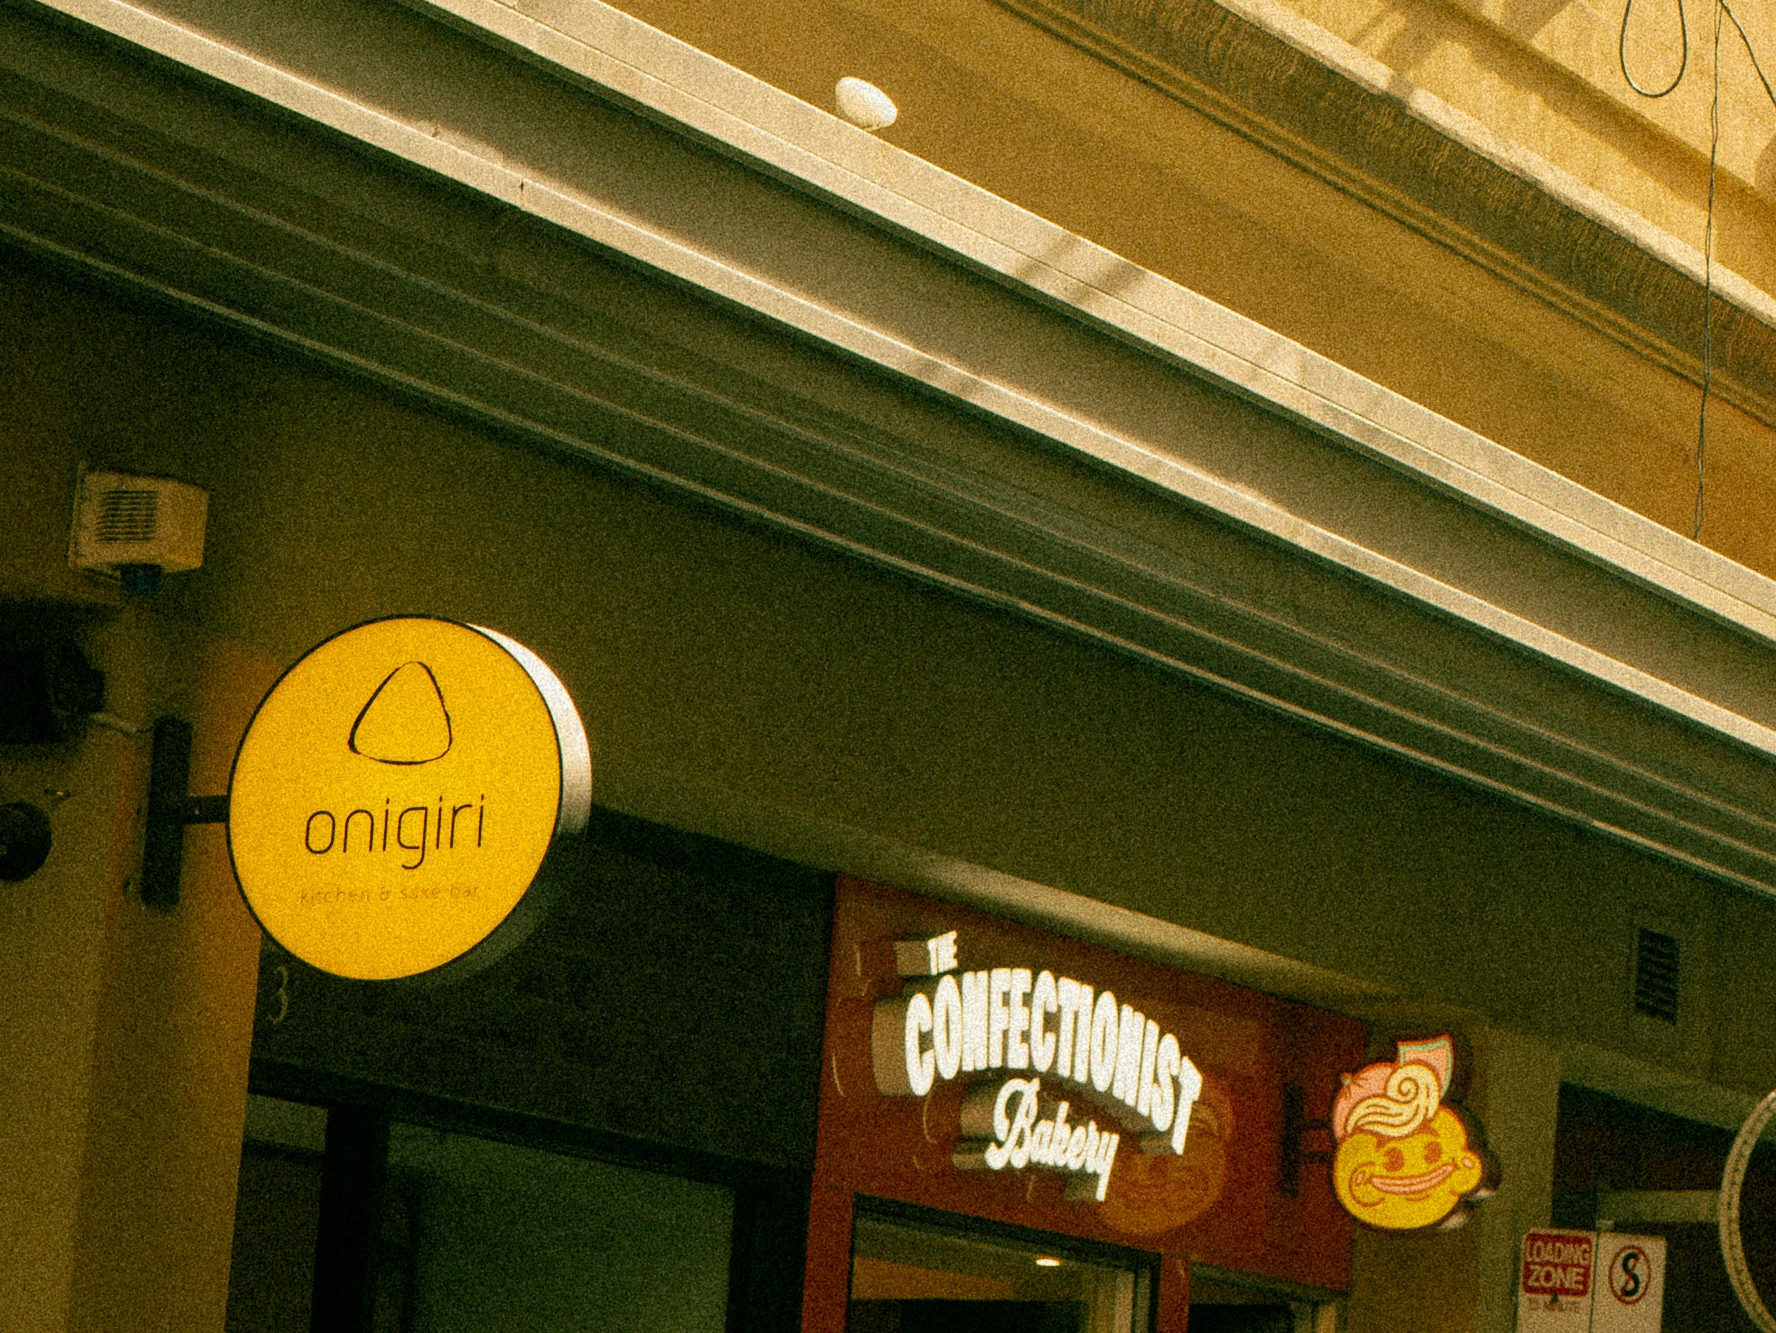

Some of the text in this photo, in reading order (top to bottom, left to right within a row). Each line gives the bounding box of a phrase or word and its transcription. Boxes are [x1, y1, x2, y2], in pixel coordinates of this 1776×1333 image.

[304, 793, 486, 870] onigiri
[904, 967, 1203, 1156] CONFECTIONIST
[984, 1077, 1120, 1202] Bakery
[1526, 1239, 1592, 1265] LOADING
[1527, 1264, 1586, 1292] ZONE
